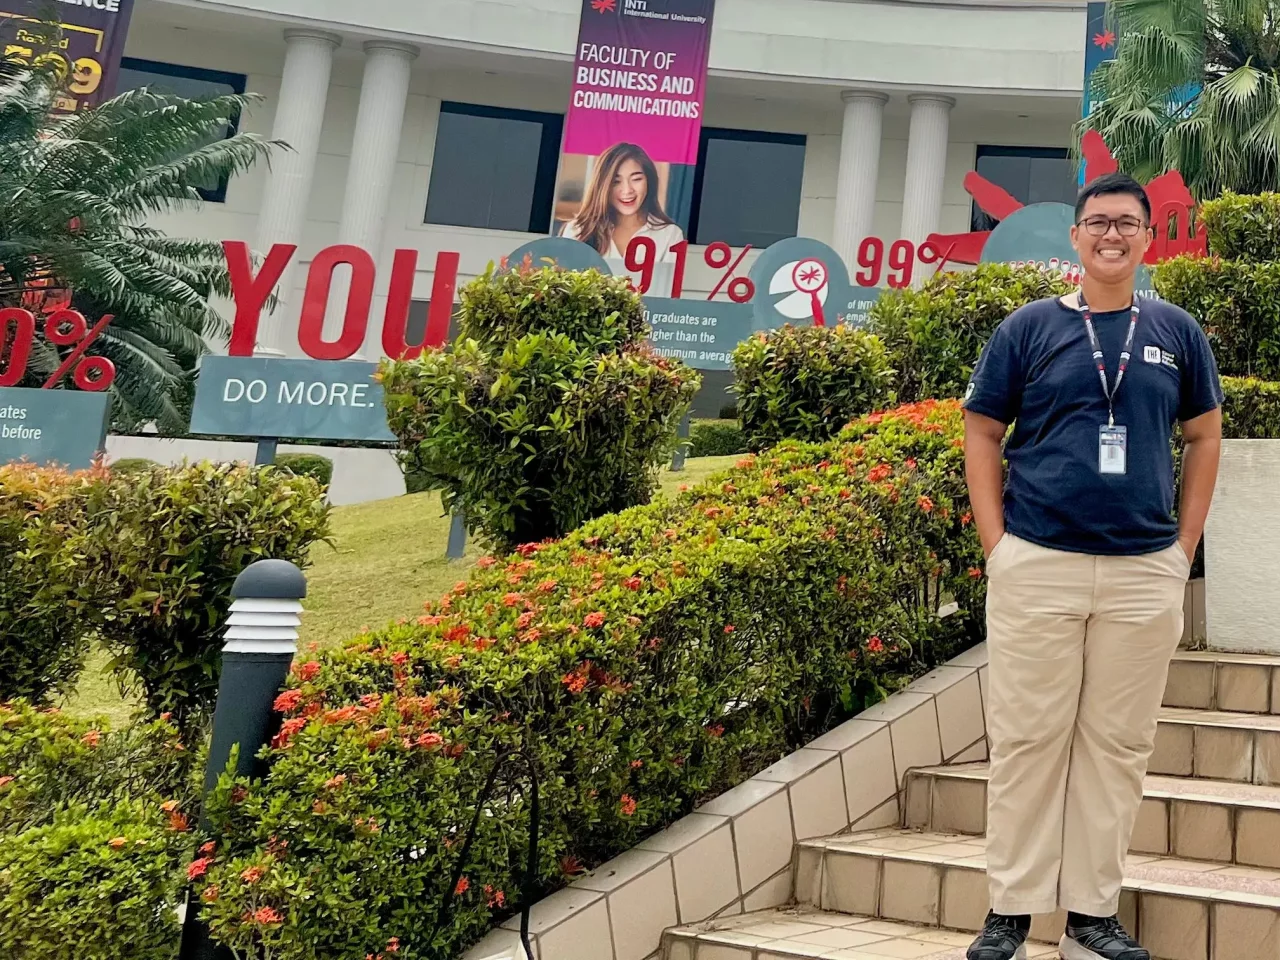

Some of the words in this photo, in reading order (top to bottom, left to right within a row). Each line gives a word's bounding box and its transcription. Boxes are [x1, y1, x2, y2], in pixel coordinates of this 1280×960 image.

[625, 0, 647, 10] INTI
[624, 8, 669, 20] International
[671, 13, 706, 24] University
[579, 43, 650, 68] FACULTY
[654, 52, 676, 70] OF
[576, 66, 658, 91] BUSINESS
[660, 76, 694, 95] AND
[573, 90, 700, 119] COMMUNICATIONS
[623, 235, 756, 304] 91%
[222, 240, 461, 361] YOU
[848, 300, 856, 309] of
[652, 312, 700, 325] graduates
[702, 317, 717, 326] are
[646, 329, 674, 342] igher
[676, 329, 697, 343] than
[700, 331, 715, 343] the
[653, 345, 697, 360] minimum
[223, 378, 268, 403] DO
[288, 381, 376, 408] MORE.
[2, 424, 42, 440] before
